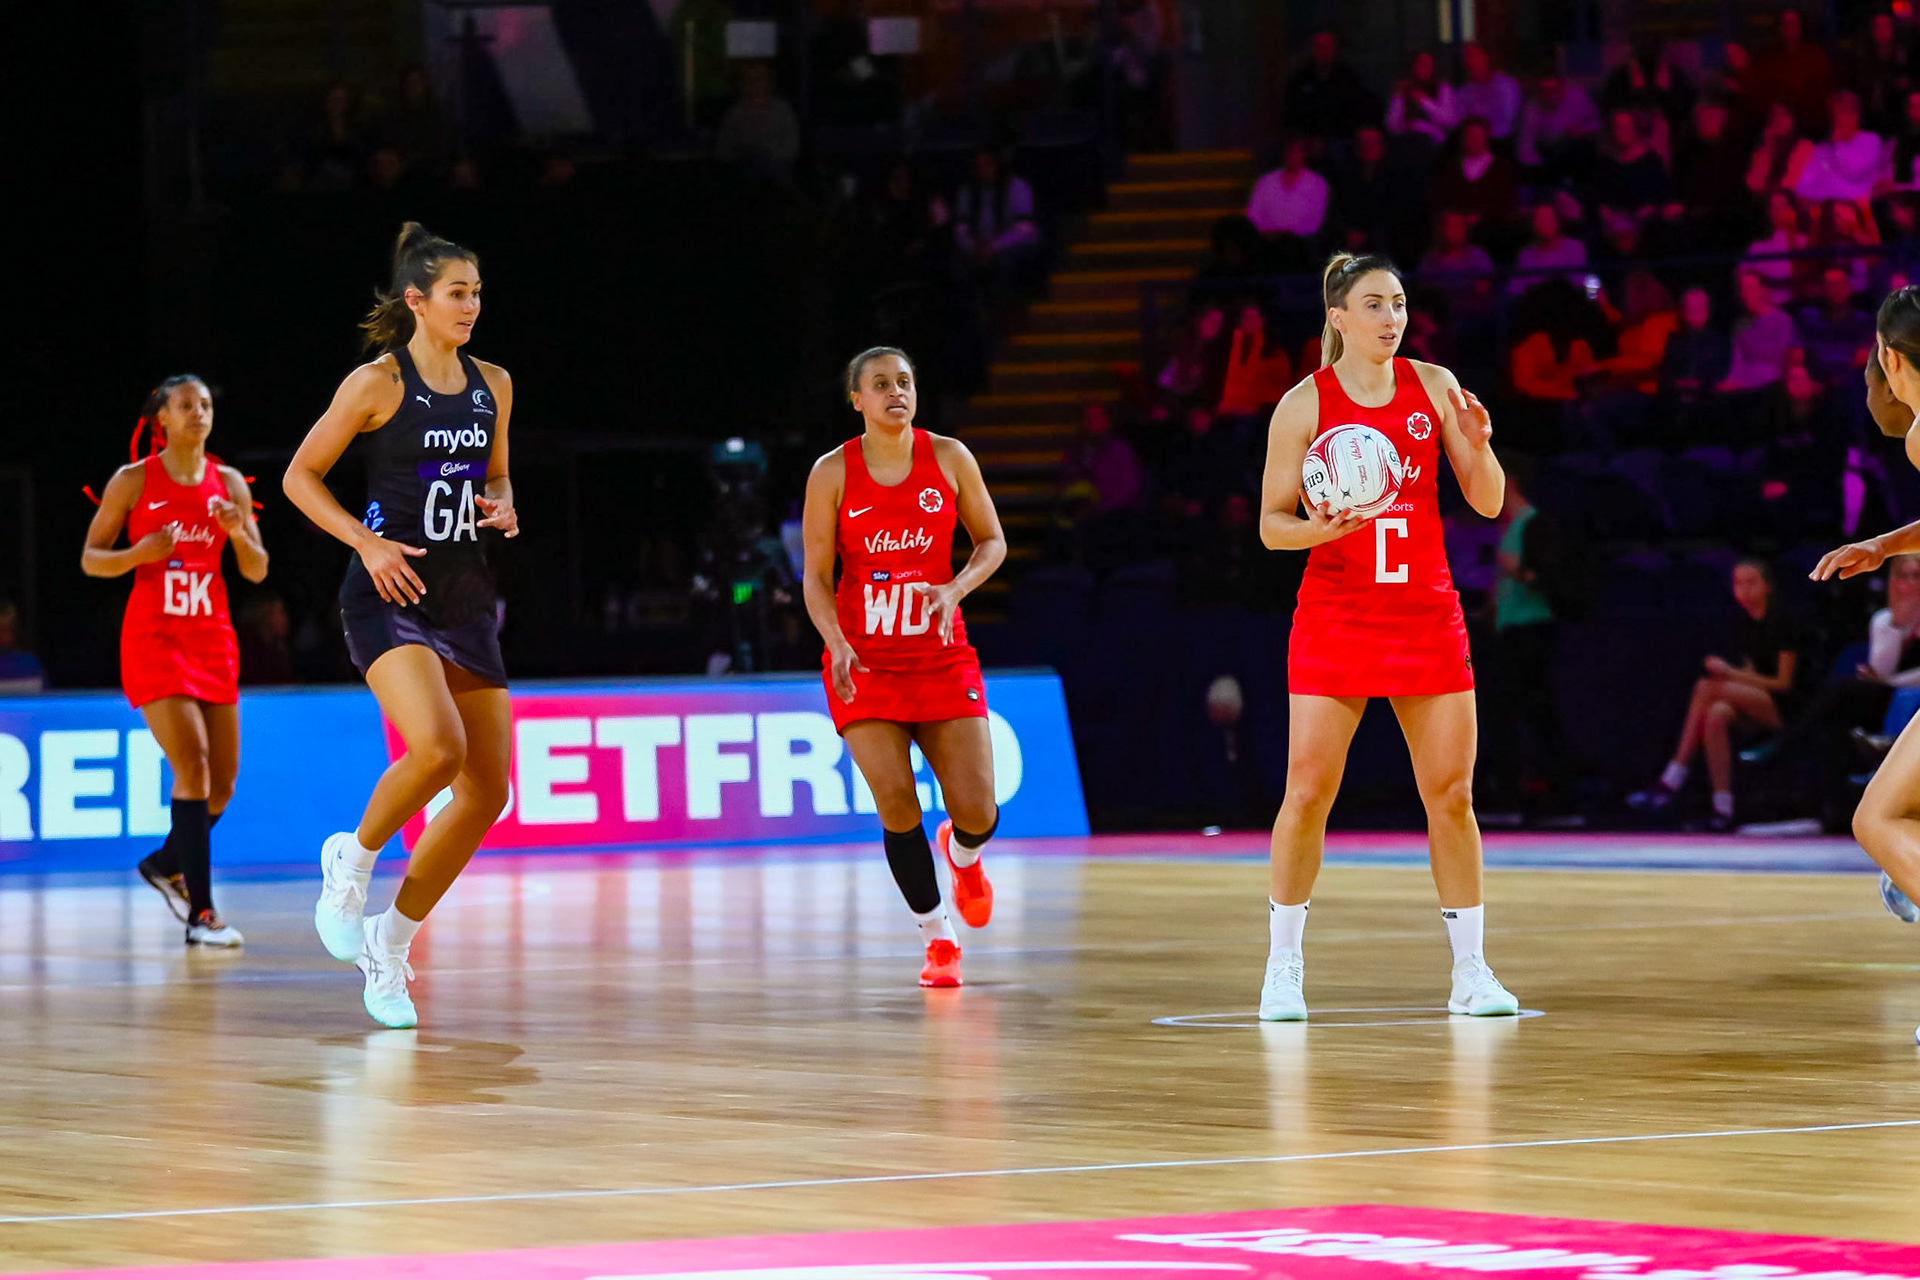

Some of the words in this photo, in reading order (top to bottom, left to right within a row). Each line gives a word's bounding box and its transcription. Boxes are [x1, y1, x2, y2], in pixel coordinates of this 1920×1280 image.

[423, 423, 488, 455] myob
[440, 462, 471, 477] Cadbury
[423, 480, 479, 542] GA
[1386, 502, 1415, 513] ports
[864, 527, 934, 555] Vitality
[1375, 518, 1409, 584] C
[163, 570, 214, 617] GK
[872, 571, 890, 581] sky
[892, 569, 923, 580] sports
[863, 581, 931, 636] WD
[424, 707, 1023, 824] ETFRD
